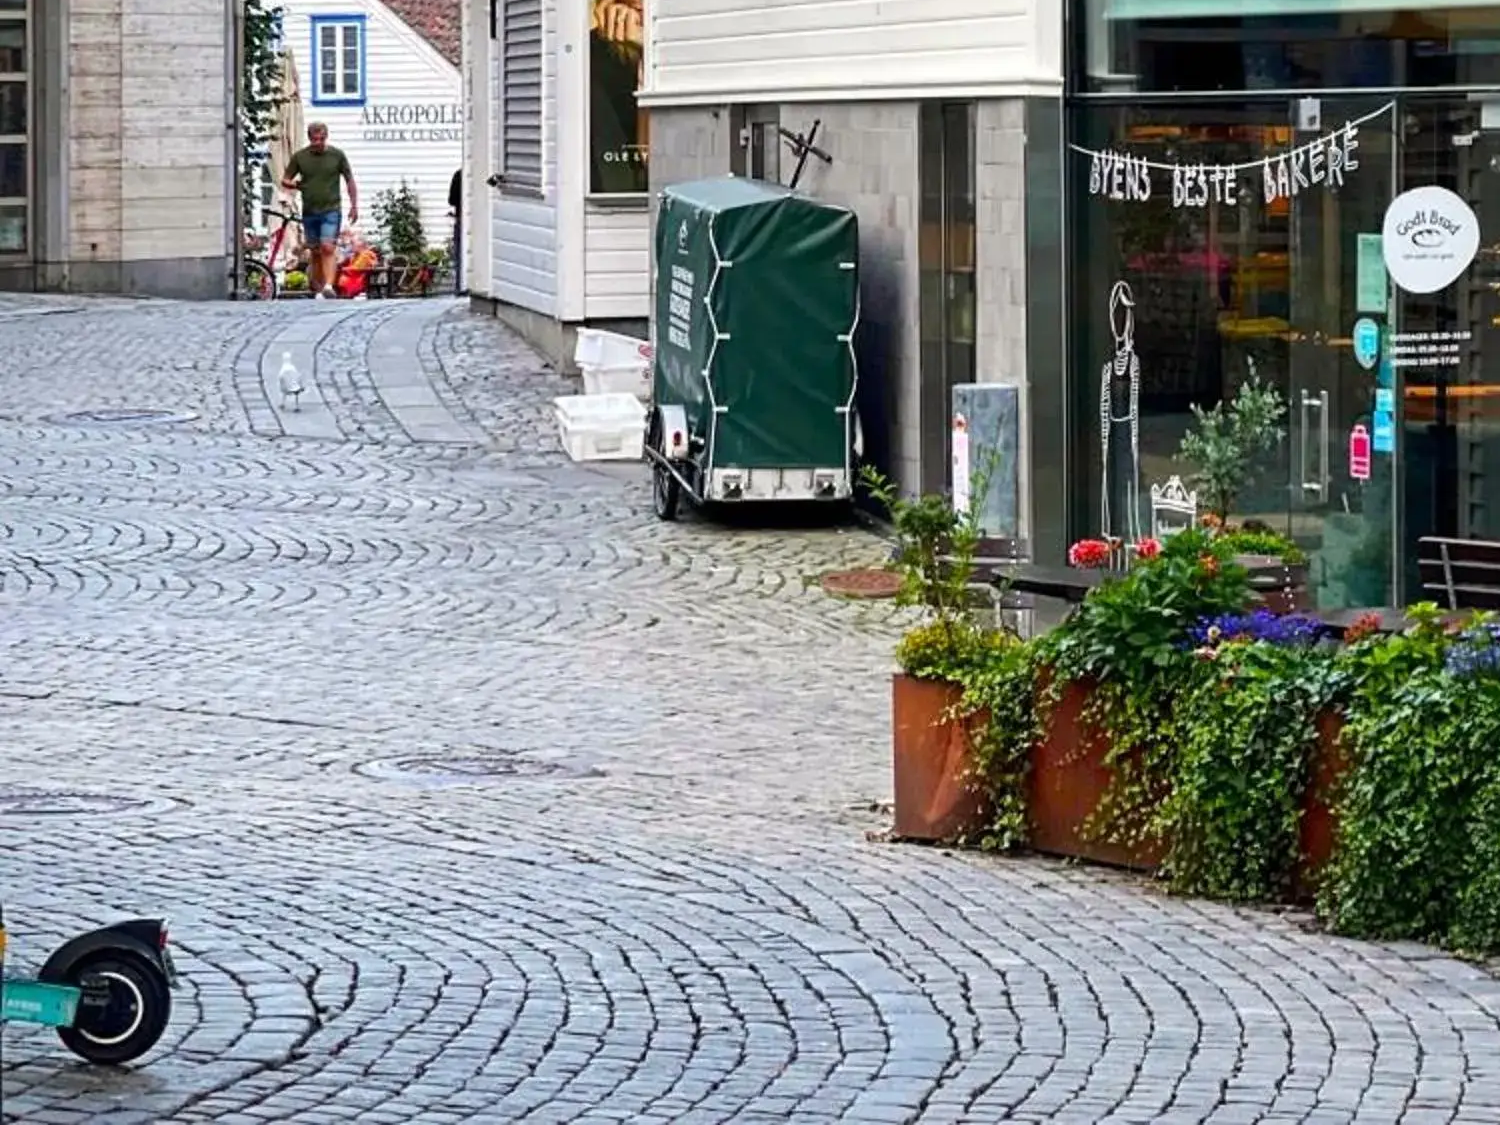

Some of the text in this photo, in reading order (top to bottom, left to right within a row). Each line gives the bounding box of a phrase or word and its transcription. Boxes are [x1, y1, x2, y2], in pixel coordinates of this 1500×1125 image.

[1089, 122, 1359, 208] BYENS BESTE BAKERE
[1396, 210, 1427, 235] Godt
